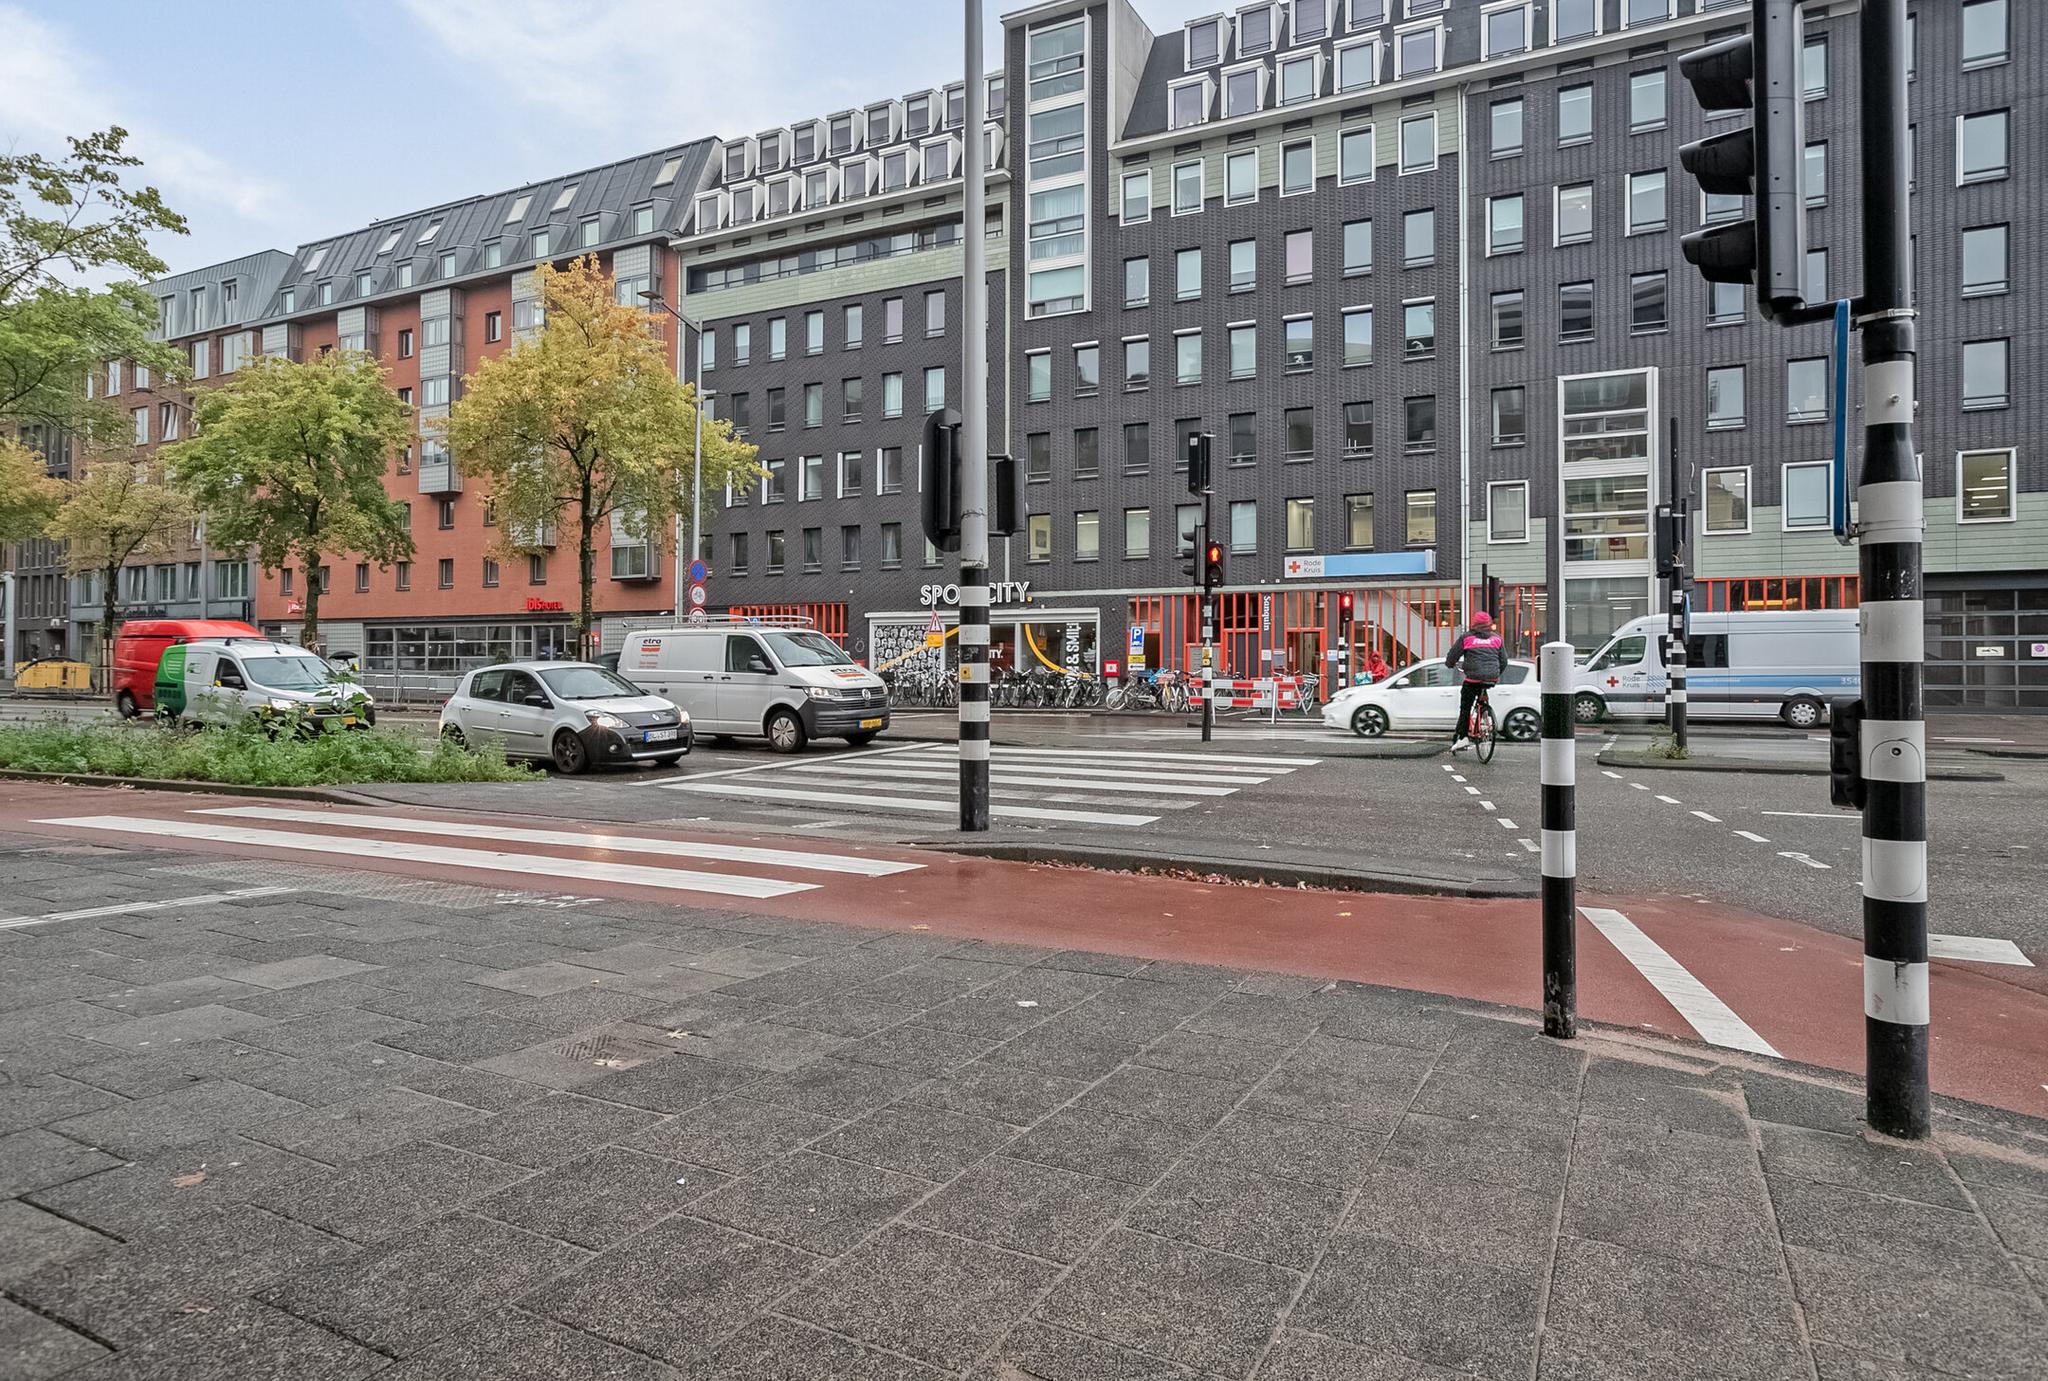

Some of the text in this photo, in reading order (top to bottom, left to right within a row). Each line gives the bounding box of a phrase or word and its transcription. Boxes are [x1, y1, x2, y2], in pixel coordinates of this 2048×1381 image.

[920, 581, 1033, 606] SPOCITY.
[1262, 595, 1271, 631] Sanquin
[1133, 629, 1142, 640] P
